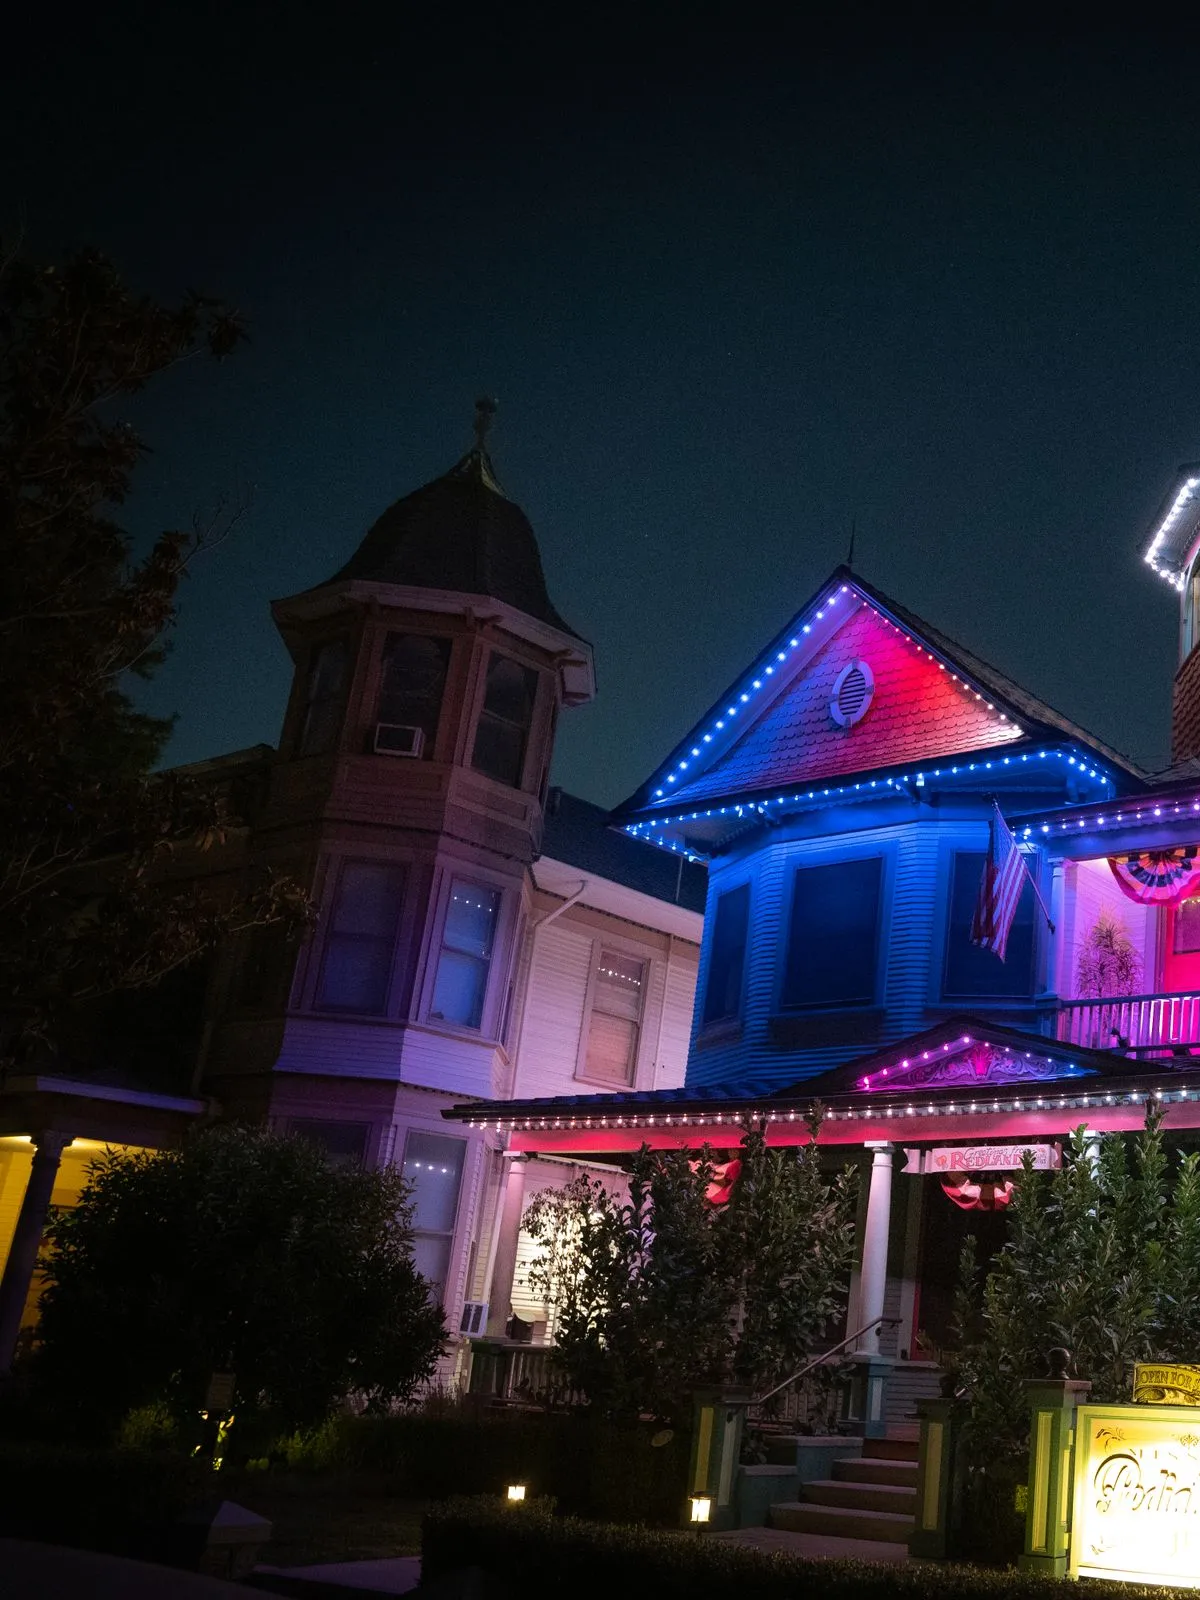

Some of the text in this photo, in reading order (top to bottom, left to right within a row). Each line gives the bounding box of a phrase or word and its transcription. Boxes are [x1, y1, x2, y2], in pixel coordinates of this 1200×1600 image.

[949, 1151, 1026, 1170] REDLAND
[1141, 1370, 1169, 1384] OPEN
[1169, 1371, 1192, 1390] FOR
